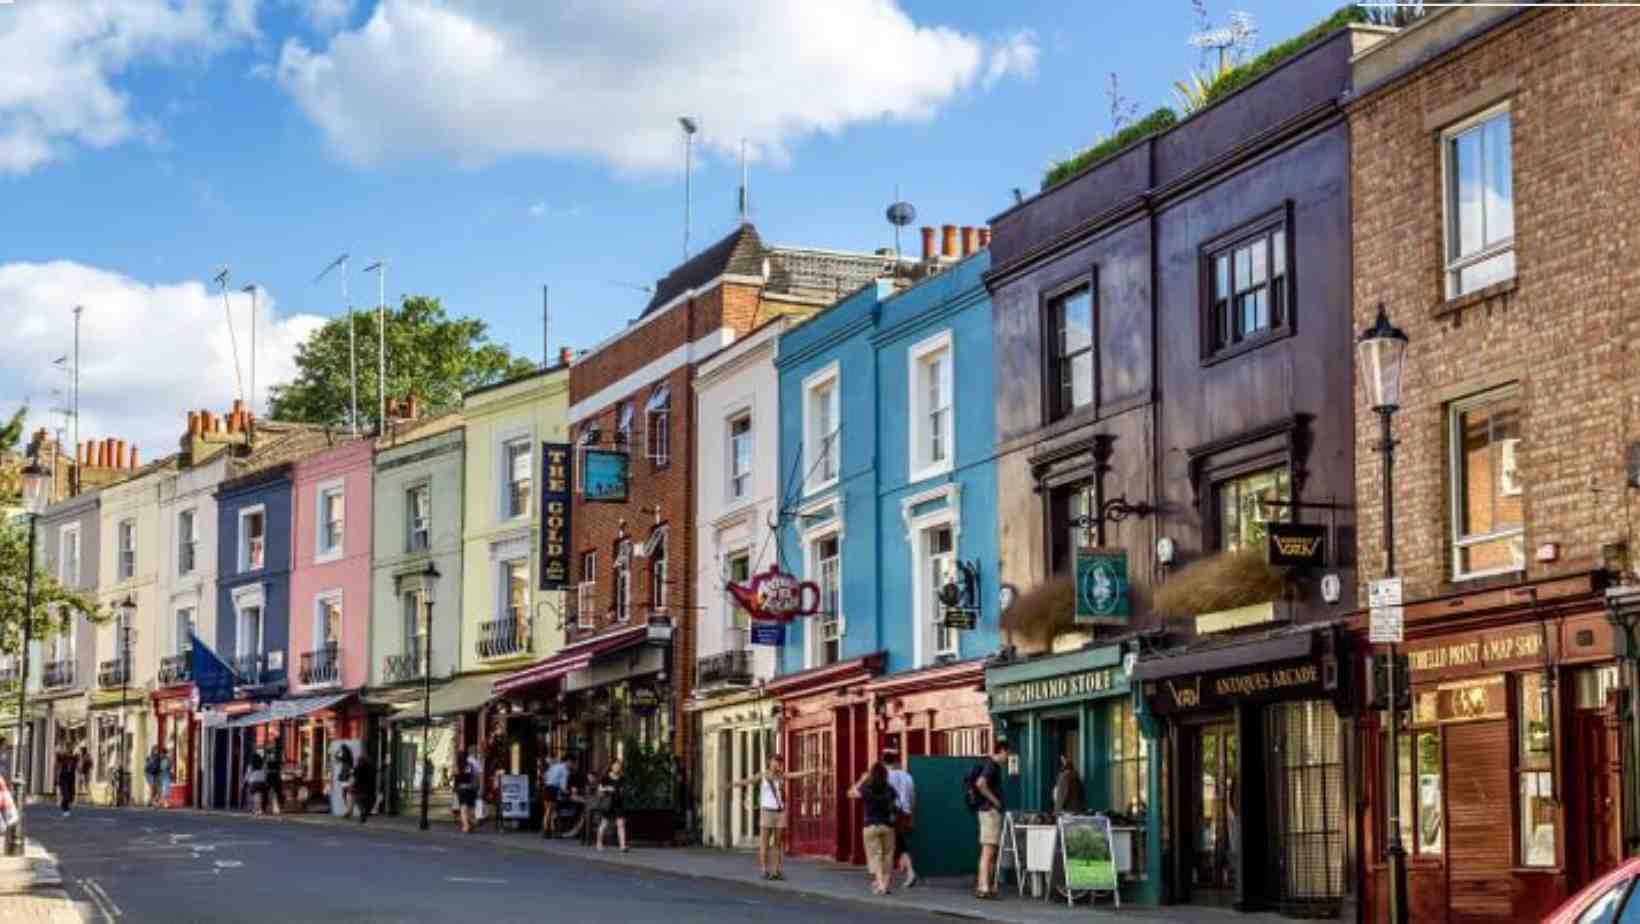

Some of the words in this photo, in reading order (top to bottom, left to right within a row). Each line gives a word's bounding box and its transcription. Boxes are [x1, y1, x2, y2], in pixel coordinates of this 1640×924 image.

[547, 451, 566, 492] THE
[547, 502, 565, 558] GOLD
[1449, 643, 1479, 665] PRINT
[1490, 639, 1514, 661] MAP
[1215, 671, 1270, 696] ANTIQUES
[1272, 664, 1320, 688] ARCADE
